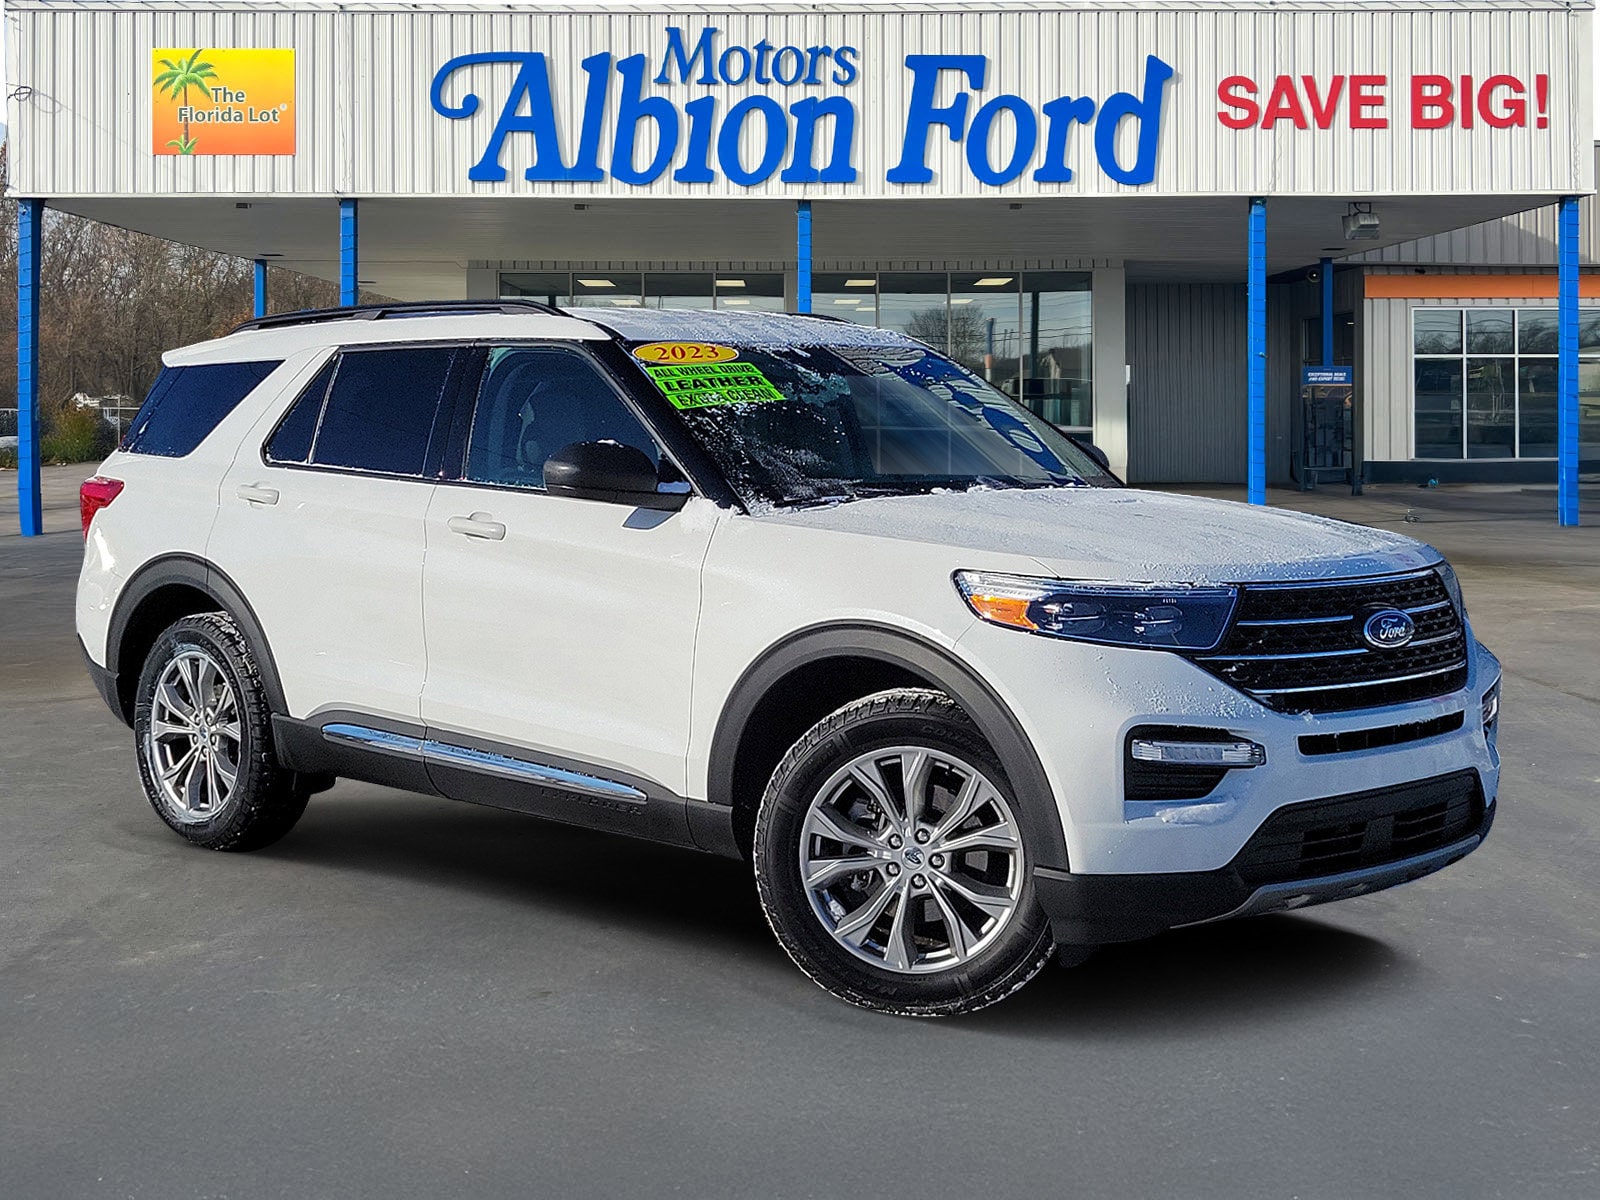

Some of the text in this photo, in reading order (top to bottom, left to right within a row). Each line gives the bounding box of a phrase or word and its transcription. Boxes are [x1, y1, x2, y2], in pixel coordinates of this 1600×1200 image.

[654, 27, 857, 86] Motors
[211, 86, 246, 103] The
[1218, 74, 1549, 130] SAVE BIG!
[178, 106, 279, 123] Florida Lot
[430, 52, 1174, 187] Albion Ford
[653, 345, 719, 361] 2023
[653, 364, 757, 378] ALL WHEEL DRIVE
[663, 376, 765, 392] LEATHER
[725, 387, 776, 401] CLEAN
[1379, 617, 1406, 640] Ford
